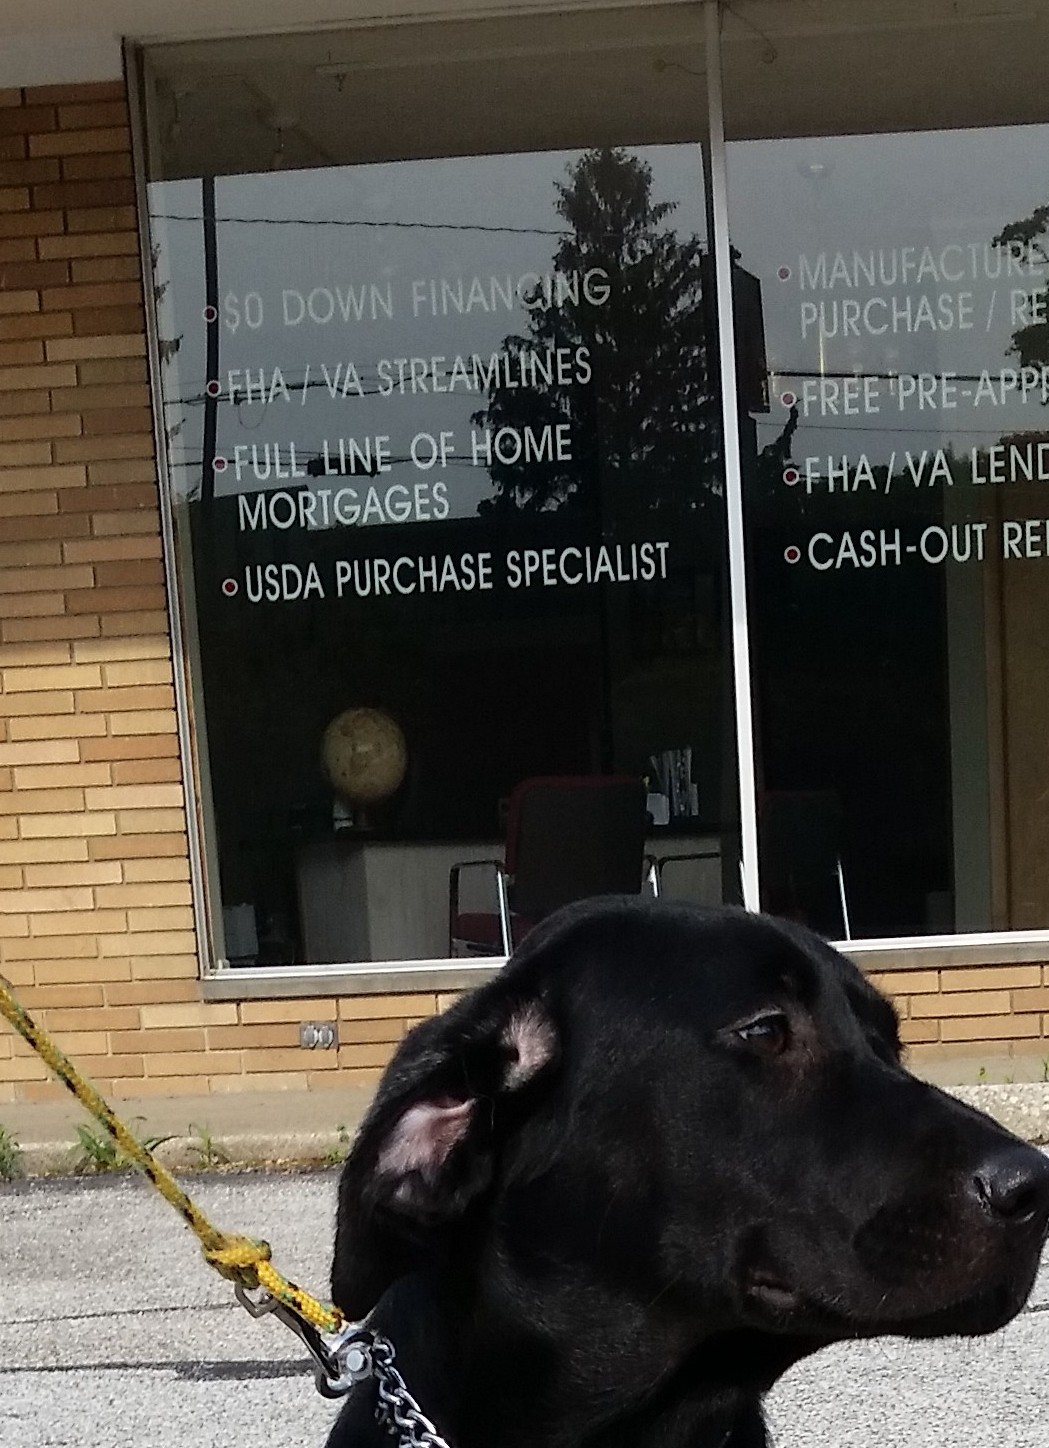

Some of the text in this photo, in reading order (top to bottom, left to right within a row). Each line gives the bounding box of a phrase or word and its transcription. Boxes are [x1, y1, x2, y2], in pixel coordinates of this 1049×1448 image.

[224, 267, 612, 334] $0 DOWN FINANCING
[801, 292, 974, 339] PURCHASE
[985, 291, 997, 332] /
[227, 366, 290, 405] FHA
[321, 362, 364, 399] VA
[377, 346, 592, 396] STREAMLINES
[802, 376, 880, 417] FREE
[233, 423, 572, 480] FULL LINE OF HOME
[805, 453, 876, 494] FHA
[905, 449, 953, 487] VA
[239, 482, 450, 531] MORTGAGES
[245, 541, 670, 602] USDA PURCHASE SPECIALIST
[808, 523, 988, 571] CASH-OUT
